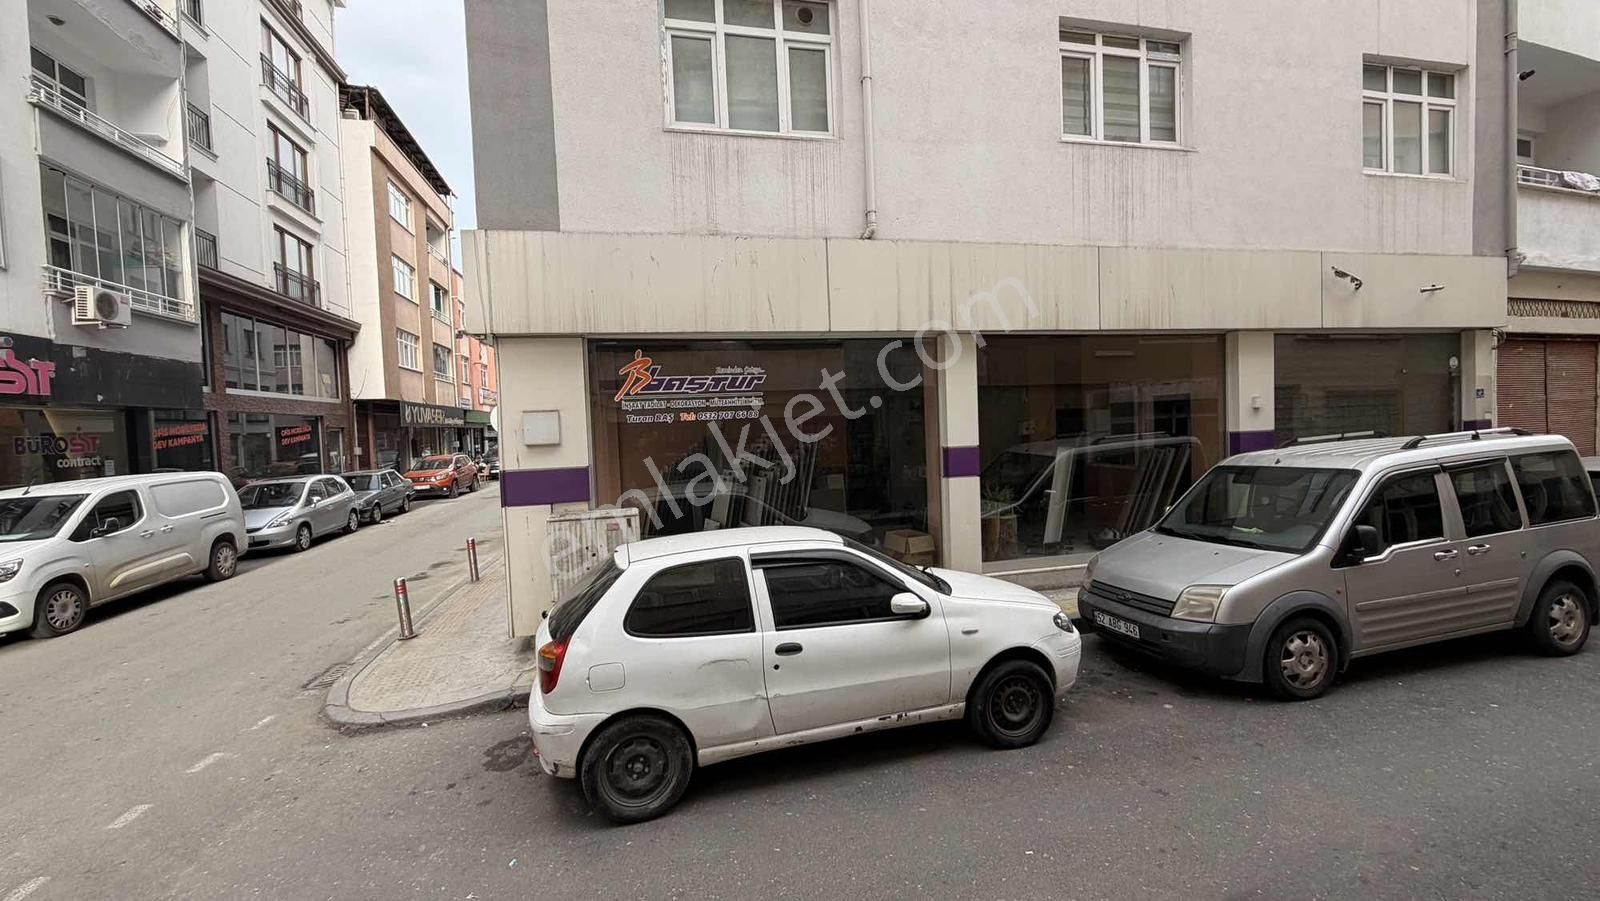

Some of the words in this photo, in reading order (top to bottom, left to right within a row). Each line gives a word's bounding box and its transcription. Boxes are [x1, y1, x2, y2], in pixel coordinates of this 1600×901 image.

[697, 411, 718, 420] 0532
[718, 411, 735, 420] 707
[735, 410, 748, 419] 66
[748, 410, 760, 419] 88
[153, 439, 167, 449] DEV
[168, 435, 204, 448] KAMPANYA
[57, 456, 102, 468] contract
[1096, 612, 1105, 625] 52
